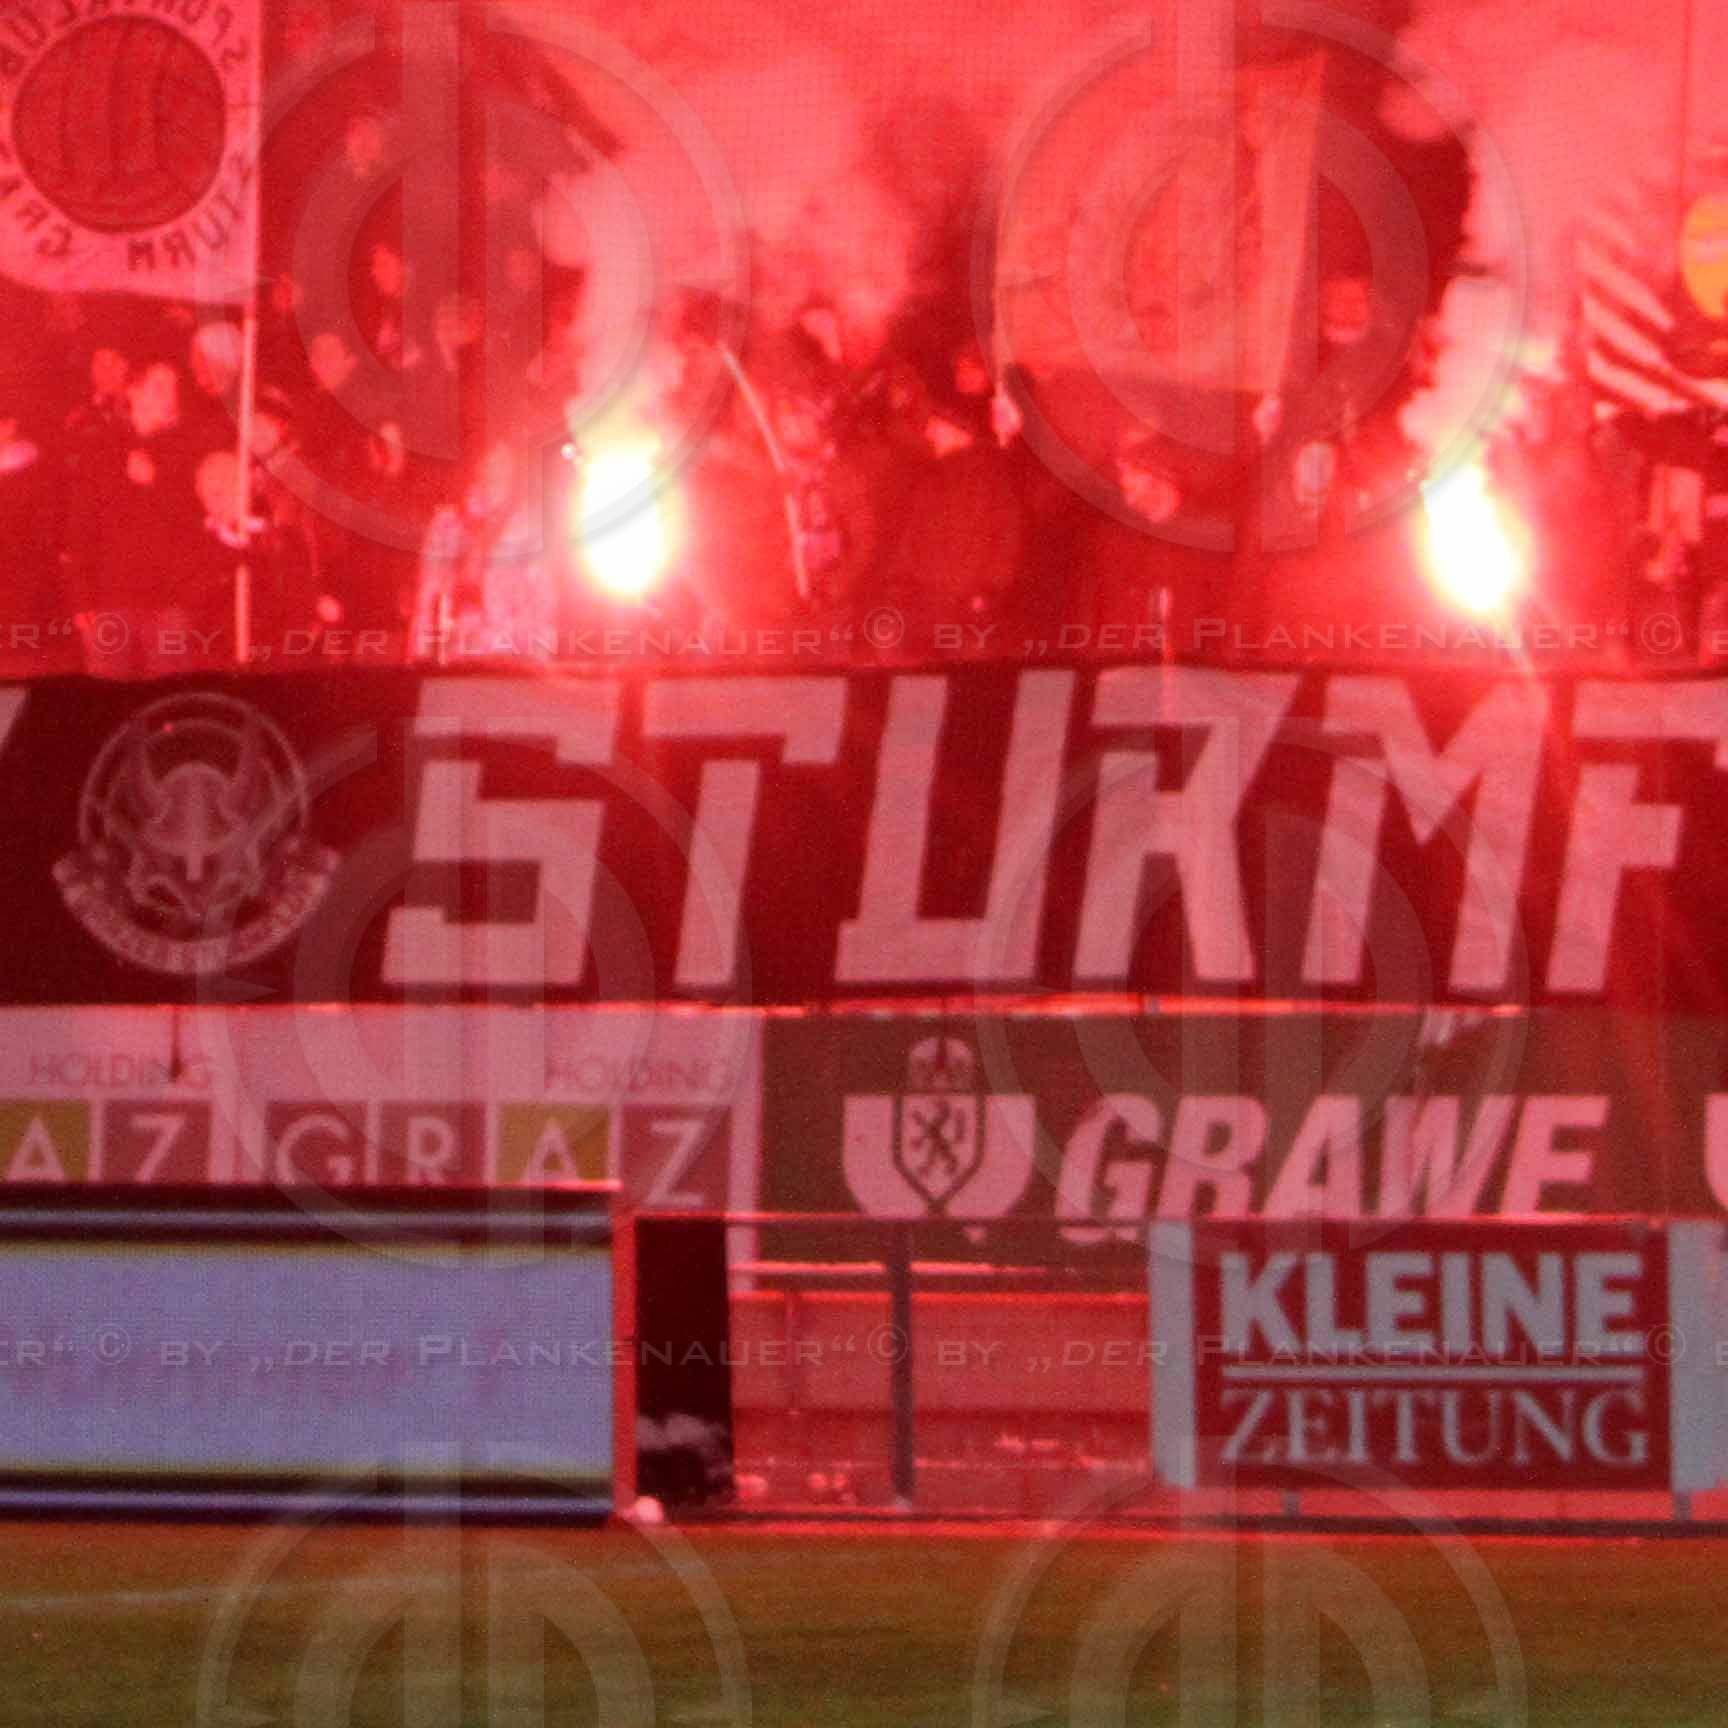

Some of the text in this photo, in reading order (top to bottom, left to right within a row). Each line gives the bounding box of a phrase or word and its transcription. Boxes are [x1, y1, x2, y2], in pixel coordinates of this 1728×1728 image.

[273, 1110, 703, 1210] GRAZ
[1054, 1091, 1610, 1241] GRAWE
[1221, 1251, 1643, 1359] KLEINE
[1221, 1388, 1647, 1466] ZEITUNG
